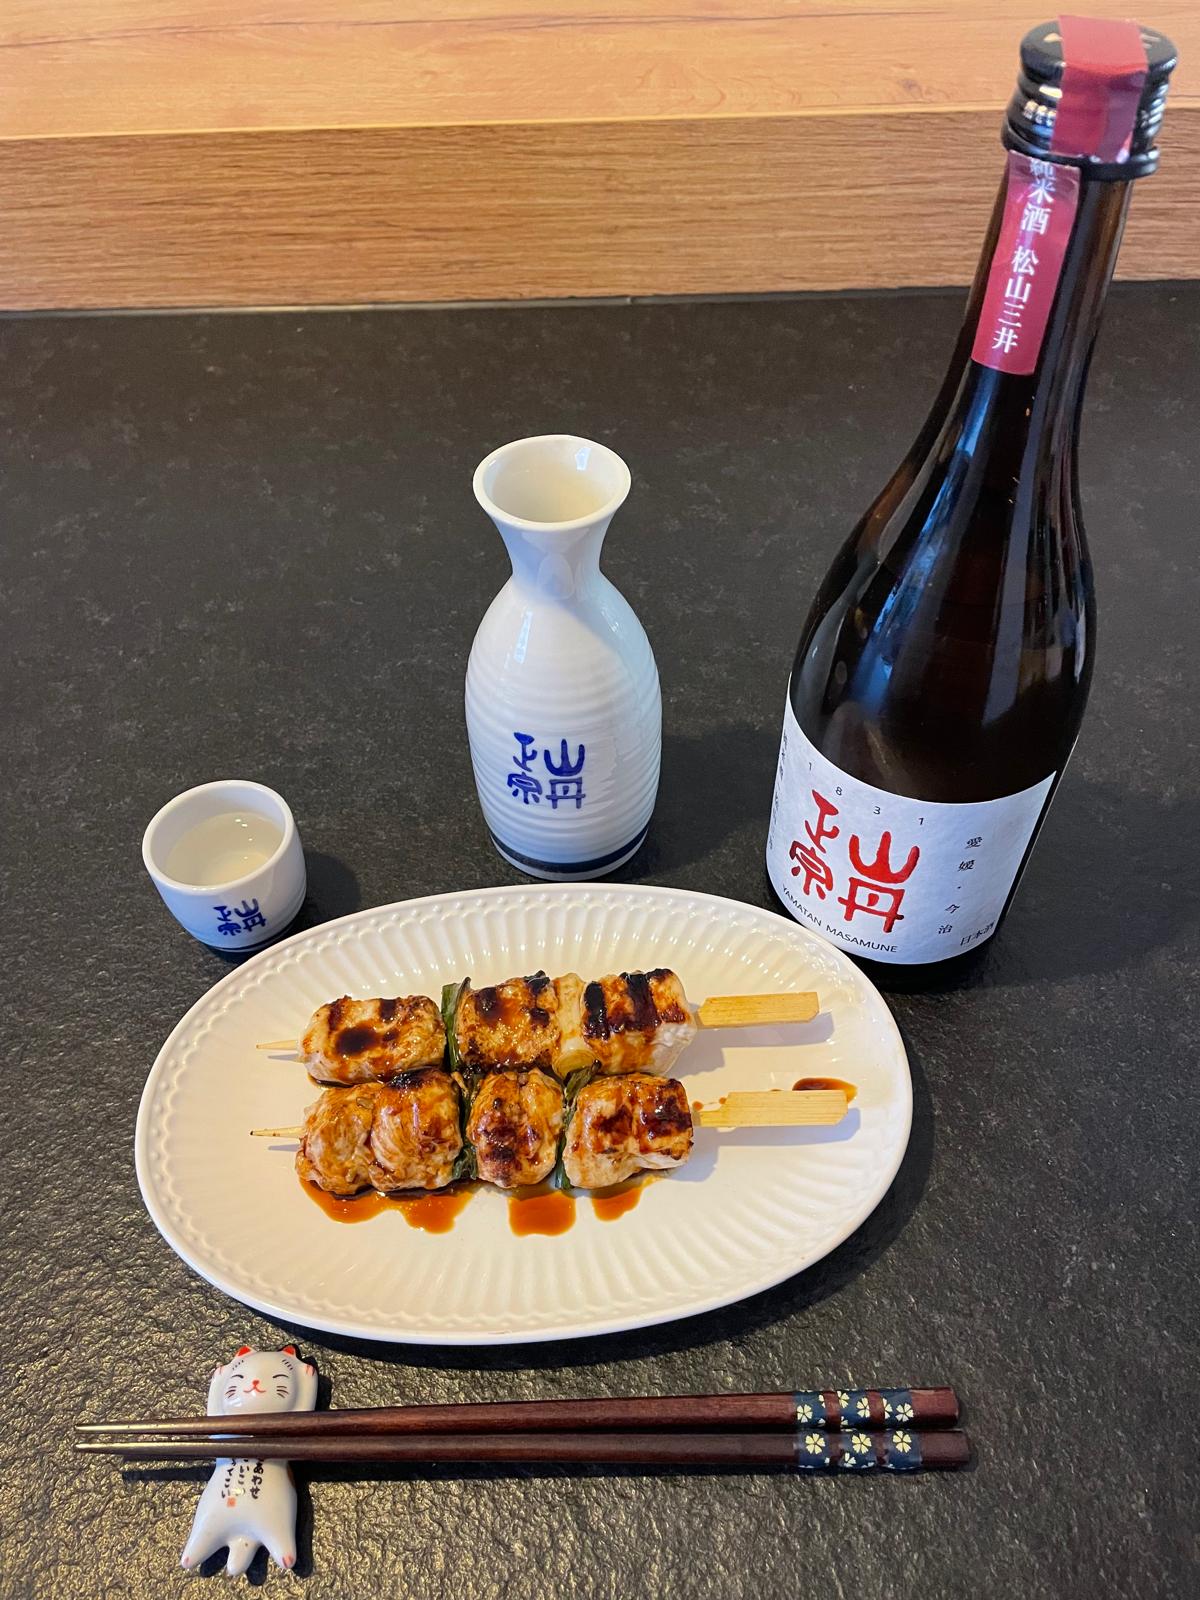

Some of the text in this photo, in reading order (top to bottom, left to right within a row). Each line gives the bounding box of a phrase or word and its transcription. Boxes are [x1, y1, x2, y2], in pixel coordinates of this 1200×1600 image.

[991, 245, 1039, 354] 松山三井
[782, 883, 899, 953] YAMATAN MASAMUNE
